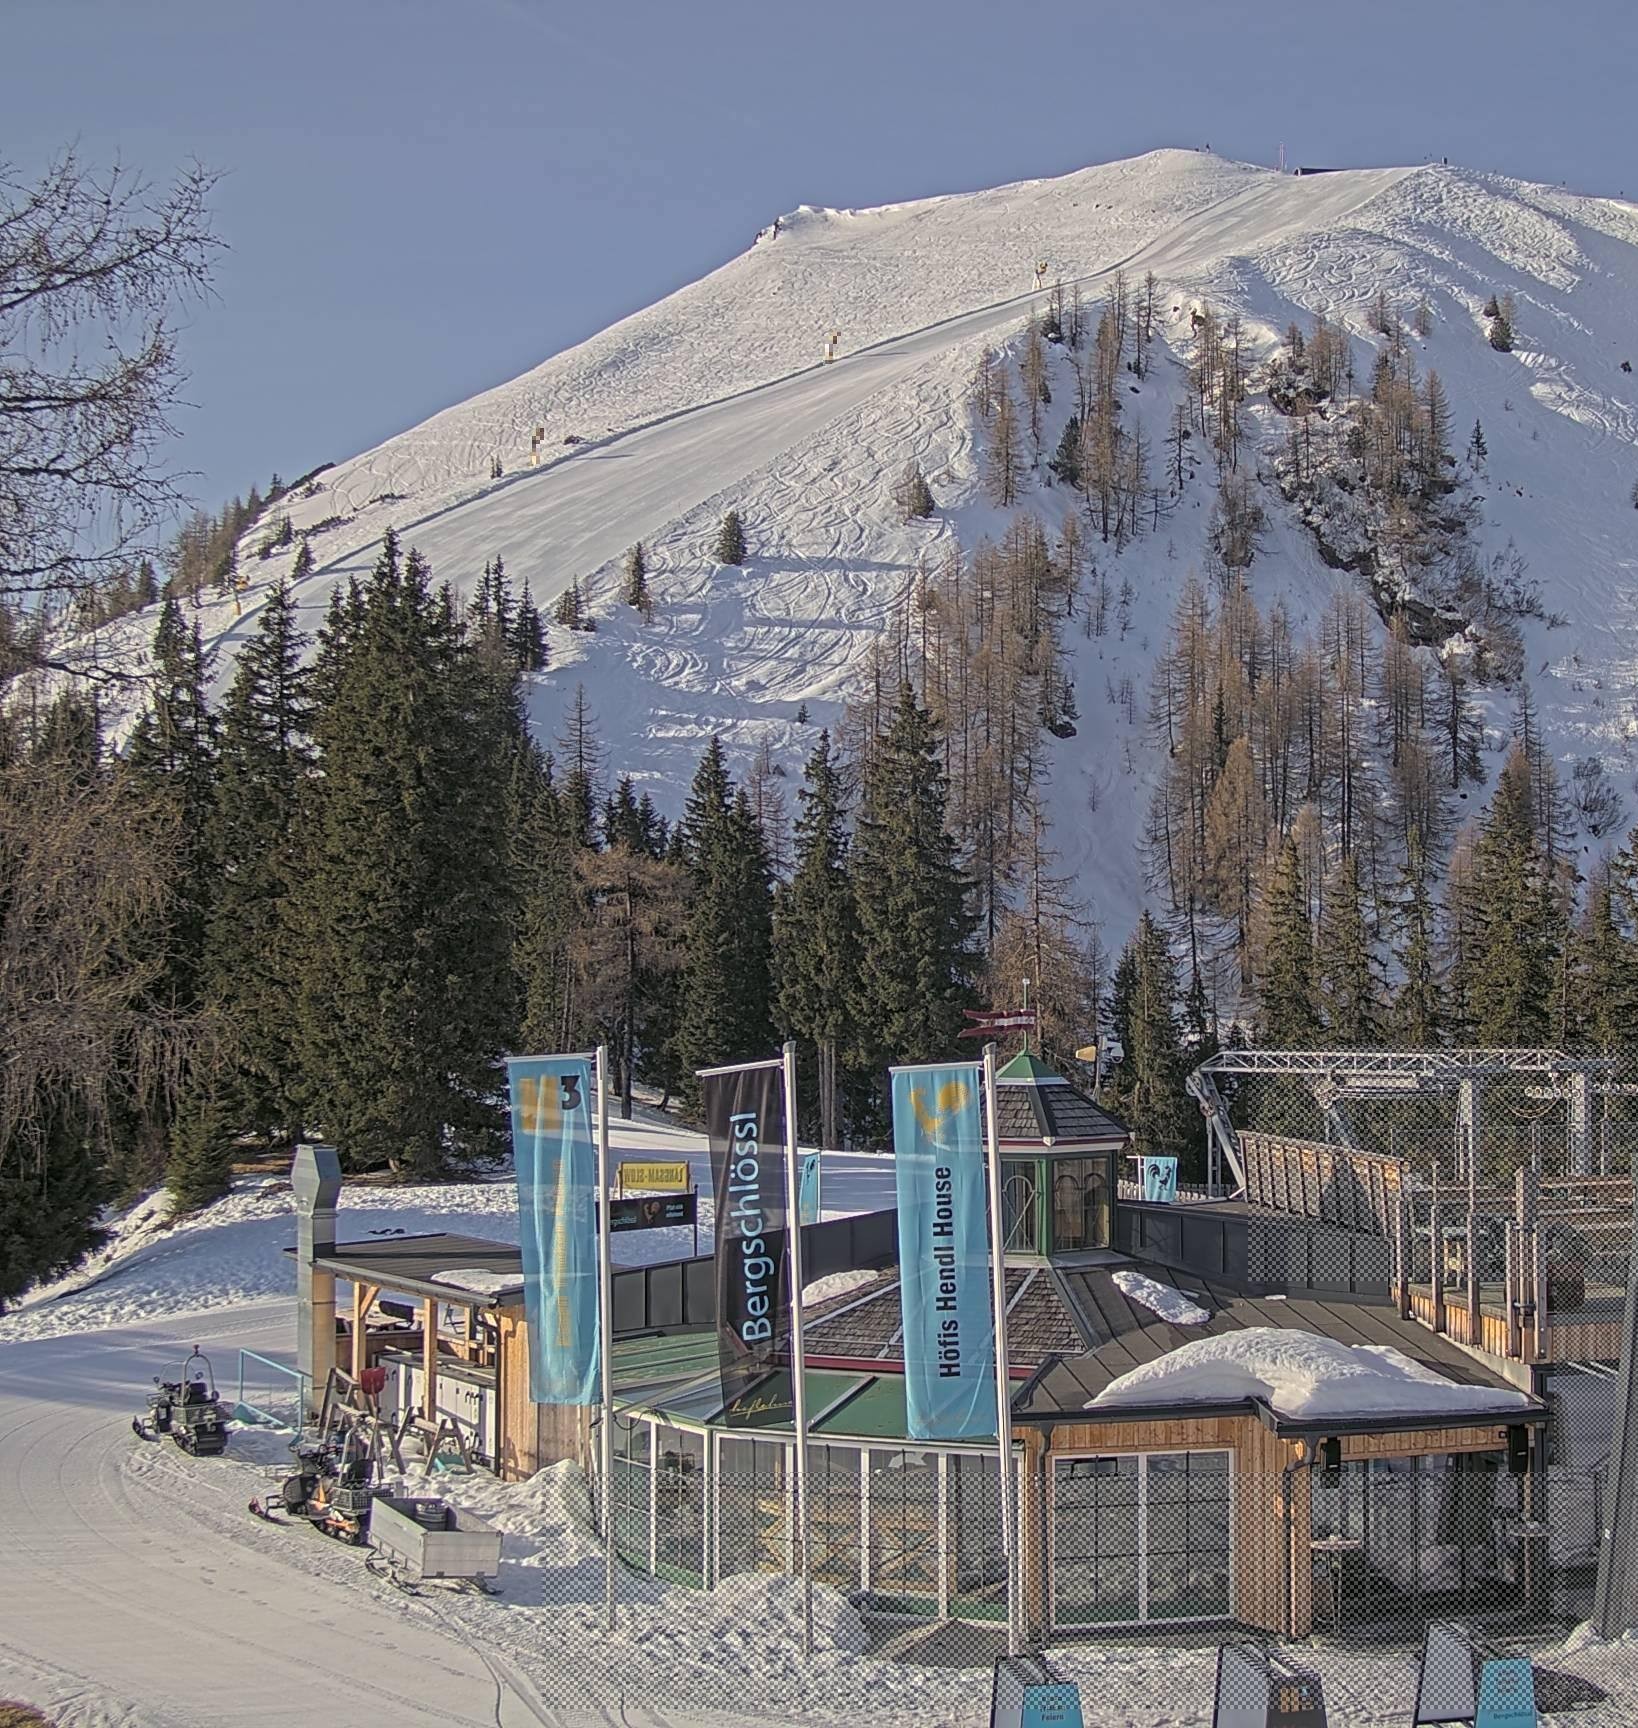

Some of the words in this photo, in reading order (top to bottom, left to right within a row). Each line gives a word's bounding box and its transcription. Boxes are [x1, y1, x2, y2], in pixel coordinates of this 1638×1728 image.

[729, 1112, 774, 1341] Bergschlössl
[933, 1167, 954, 1237] House
[934, 1246, 957, 1311] Hendl
[938, 1319, 961, 1378] Höfis
